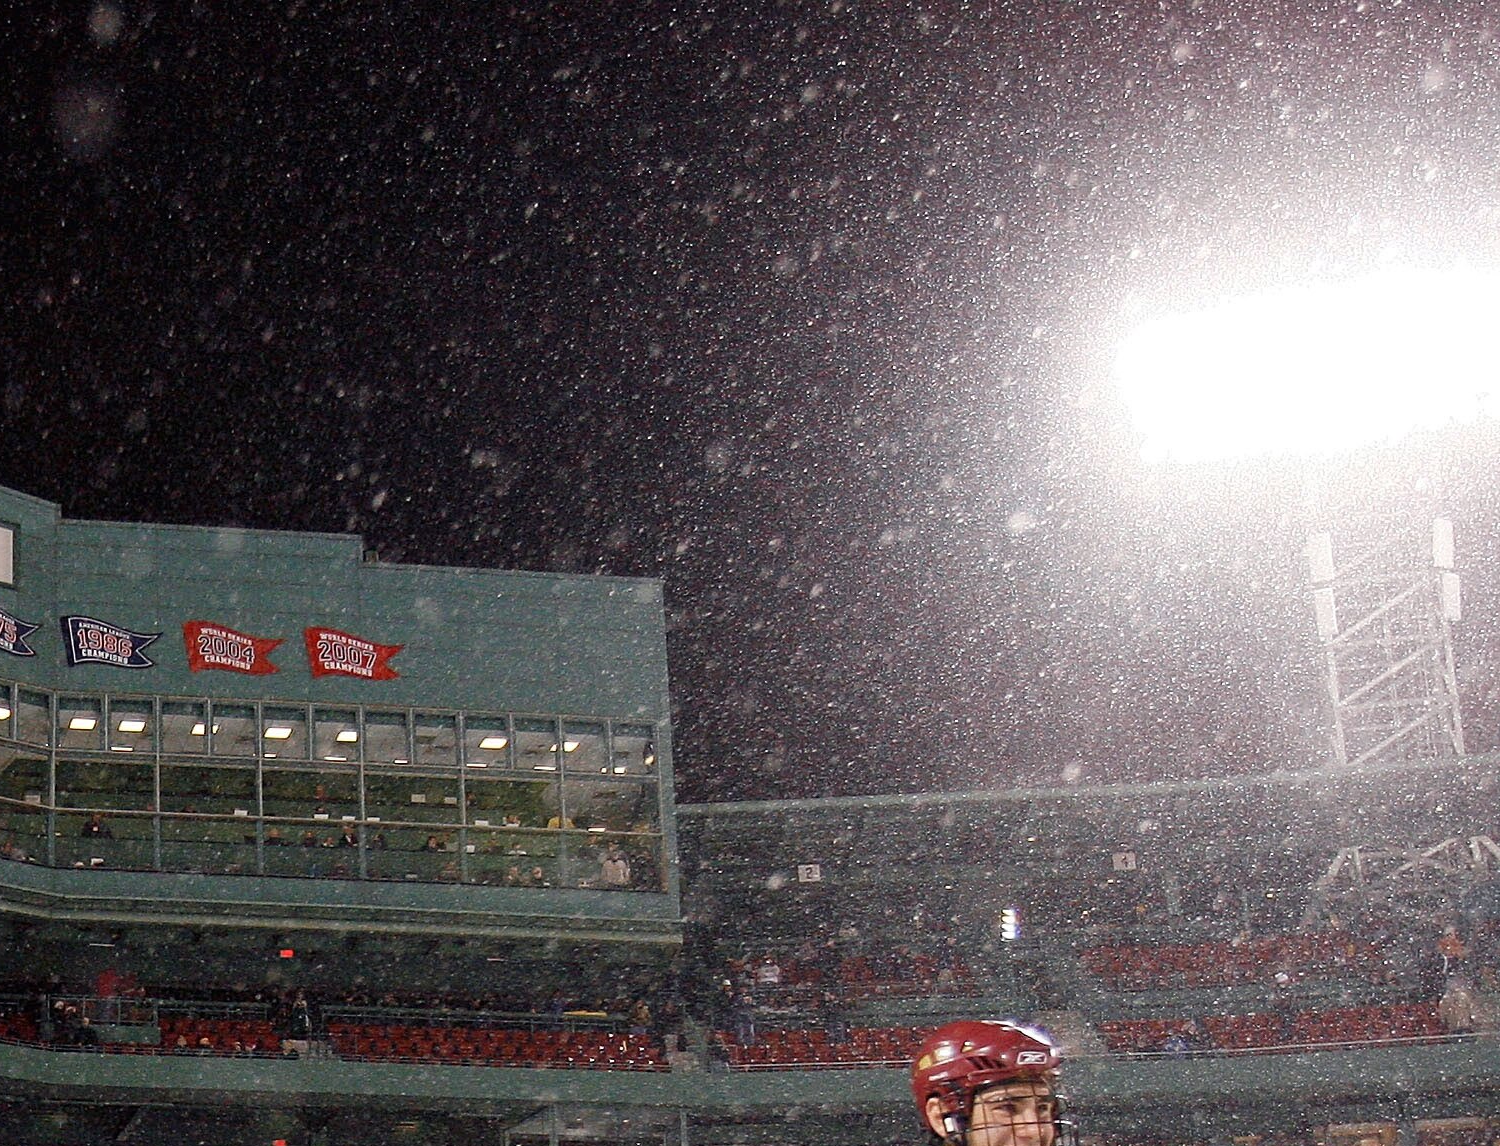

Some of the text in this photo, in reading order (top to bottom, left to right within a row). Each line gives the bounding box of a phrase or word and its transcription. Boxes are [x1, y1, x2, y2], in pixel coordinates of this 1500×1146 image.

[77, 628, 133, 658] 1986
[198, 634, 255, 664] 2004
[316, 640, 377, 669] 2007
[81, 648, 129, 665] CHAMPIONS
[204, 654, 250, 670] CHAMPIONS
[324, 661, 373, 677] CHAMPIONS
